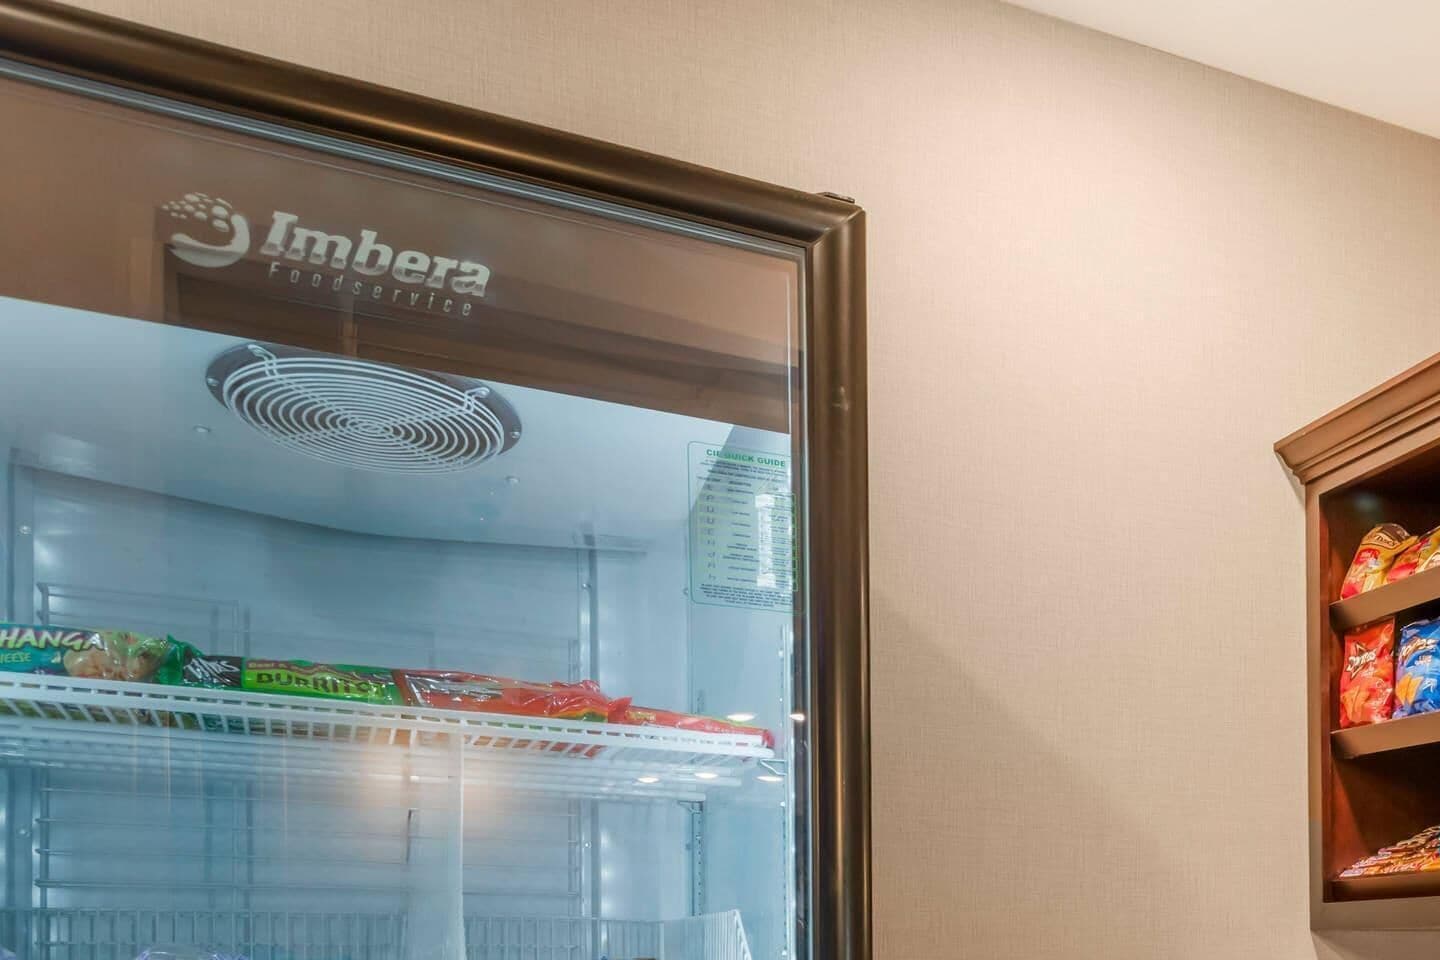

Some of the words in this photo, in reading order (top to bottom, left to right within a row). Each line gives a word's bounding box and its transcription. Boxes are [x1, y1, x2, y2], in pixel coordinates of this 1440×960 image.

[260, 210, 491, 297] Imbera
[268, 261, 473, 317] Foodservice
[757, 457, 786, 467] GUIDE
